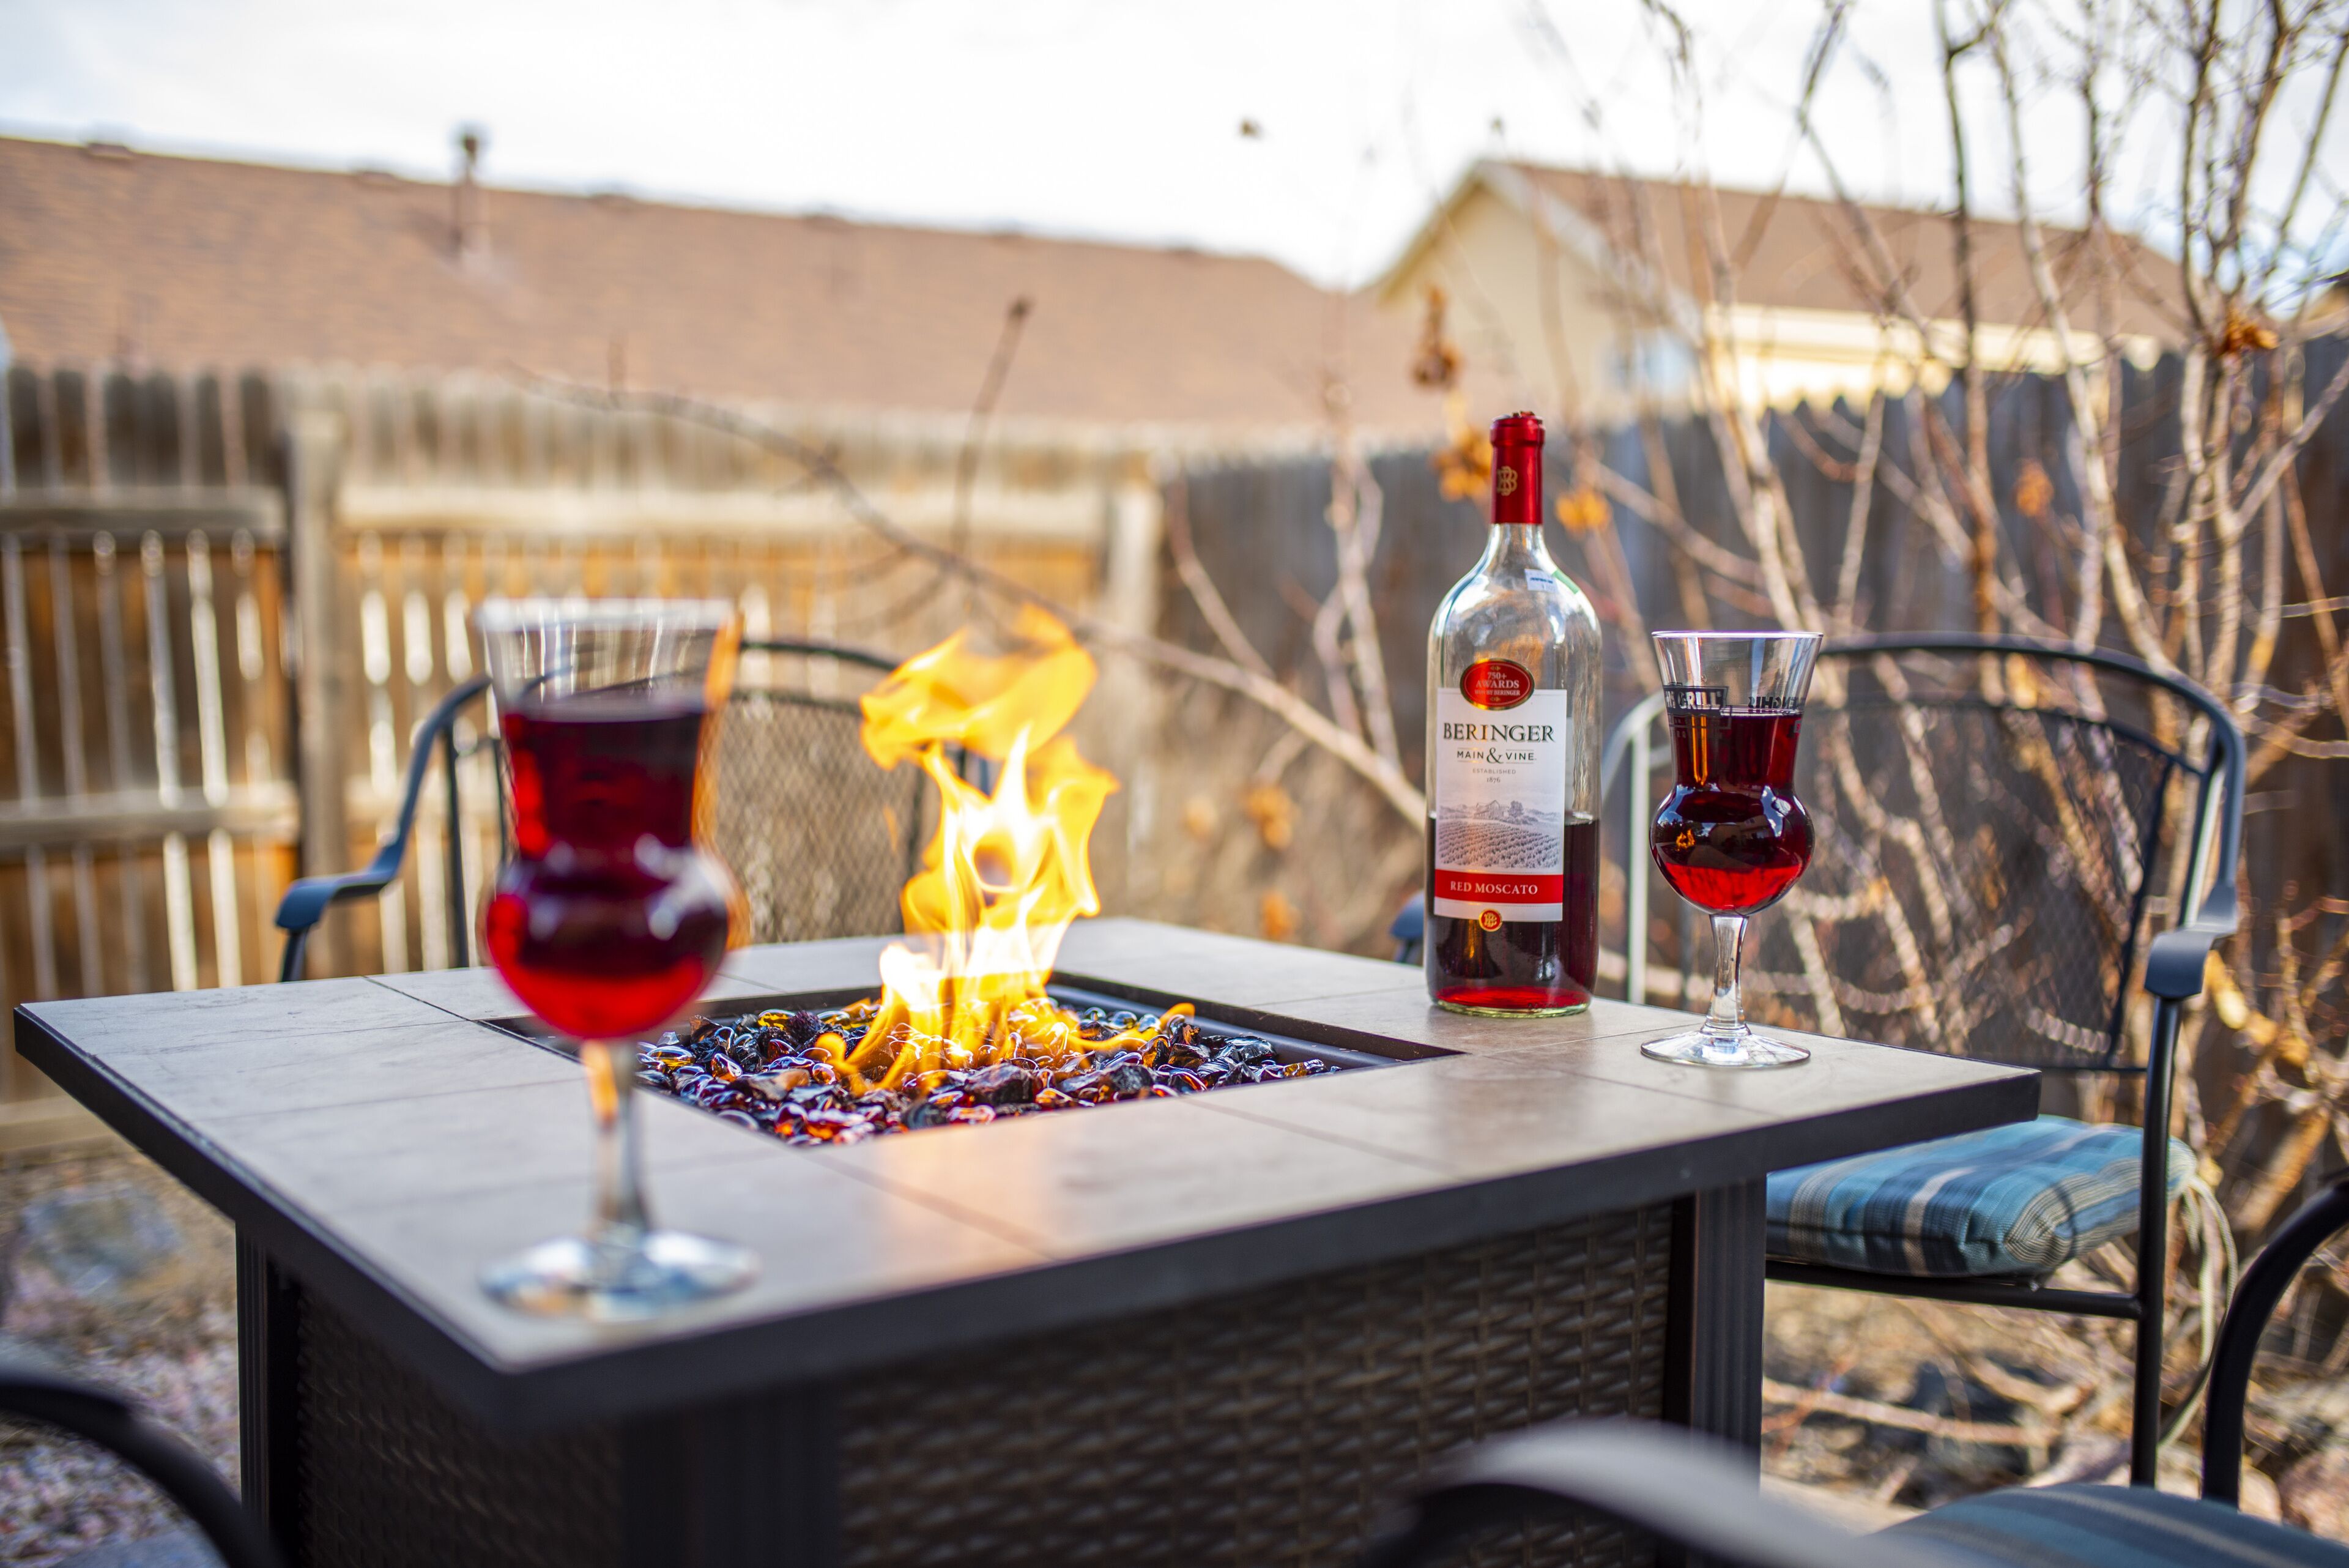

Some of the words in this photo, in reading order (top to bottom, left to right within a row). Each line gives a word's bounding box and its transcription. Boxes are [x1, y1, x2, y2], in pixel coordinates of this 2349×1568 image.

[1475, 680, 1520, 688] AWARDS
[1443, 723, 1556, 742] BERINGER
[1457, 750, 1484, 759] MAIN
[1486, 747, 1504, 764] &
[1506, 752, 1534, 760] VINE
[1450, 881, 1471, 892] RED
[1475, 883, 1538, 894] MOSCATO
